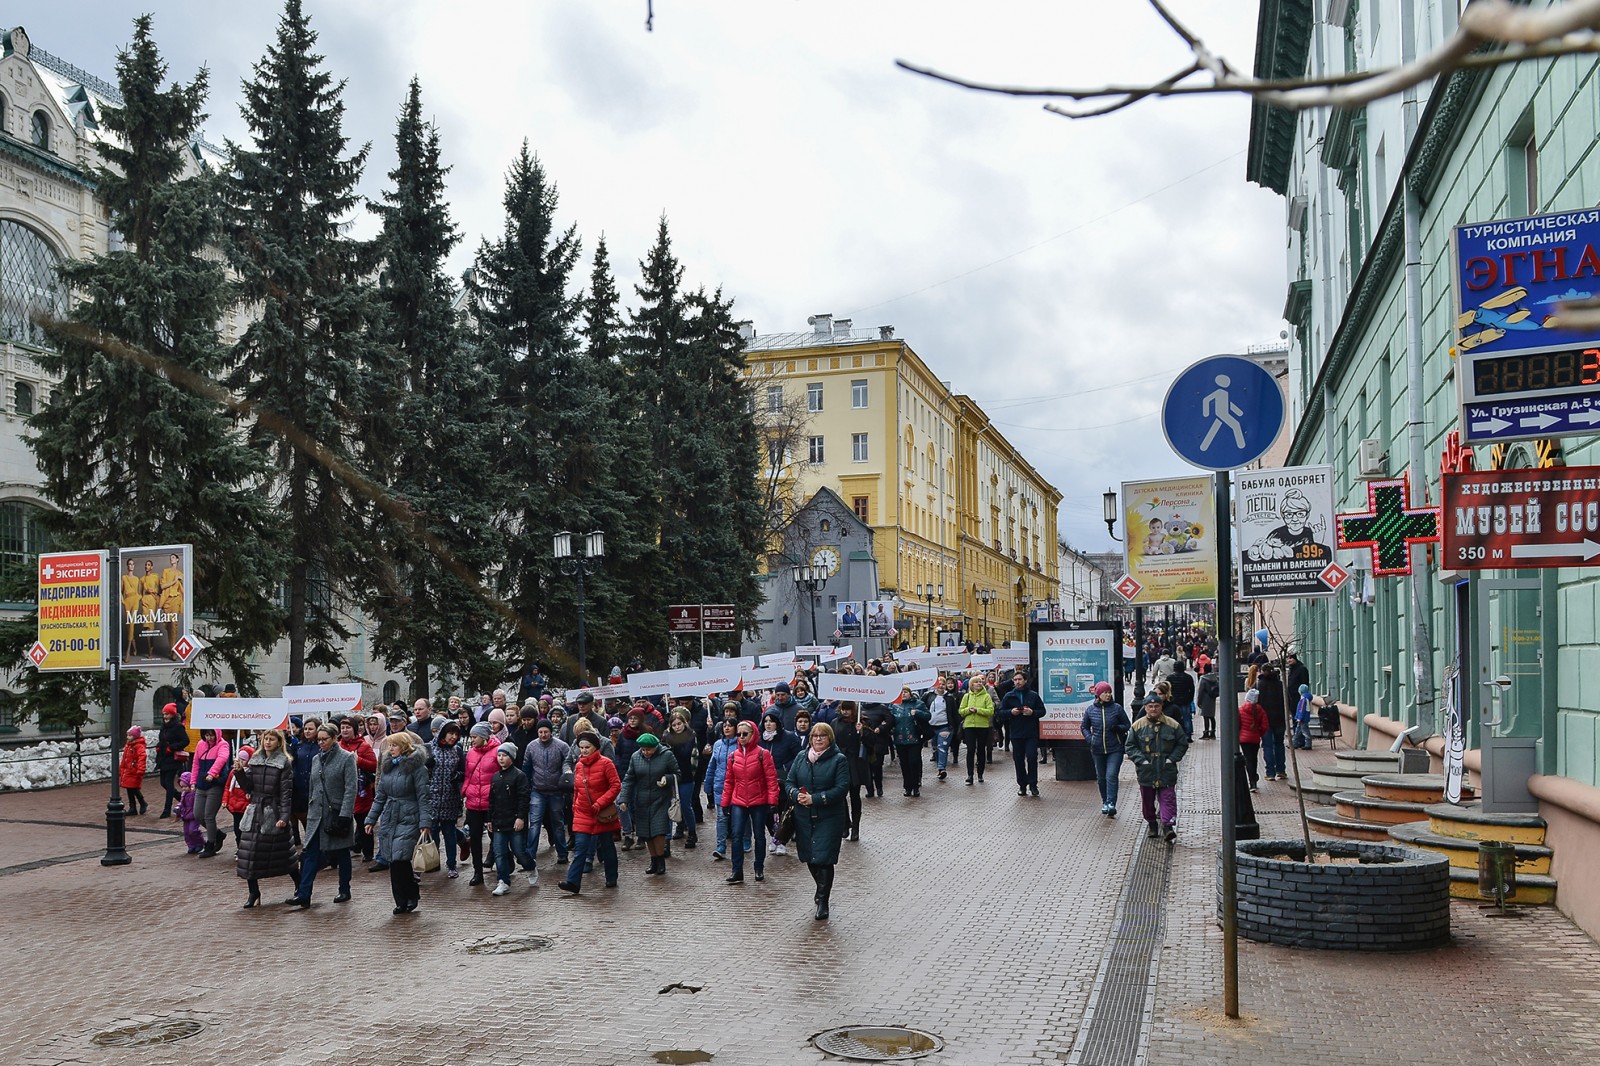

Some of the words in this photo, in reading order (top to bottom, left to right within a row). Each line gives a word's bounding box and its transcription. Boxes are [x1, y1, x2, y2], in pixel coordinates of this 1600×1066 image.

[1464, 211, 1600, 239] ТУРИСТИЧЕСКАЯ
[1487, 229, 1577, 251] КОМПАНИЯ
[1471, 408, 1489, 418] Ул.
[1492, 401, 1568, 417] Грузинская
[1160, 484, 1203, 492] МЕДИЦИНСКАЯ
[1242, 479, 1275, 490] БАБУЛЯ
[1279, 474, 1326, 487] ОДОБРЯЕТ
[1462, 477, 1600, 496] ХУДОЖЕСТВЕННЫ
[1161, 499, 1190, 507] Персона
[1247, 497, 1276, 514] ЛЕПИ
[1456, 497, 1542, 536] МУЗЕЙ
[1458, 547, 1486, 560] 350
[56, 568, 98, 578] ЭКСПЕРТ
[1243, 562, 1281, 572] ПЕЛЬМЕНИ
[1282, 561, 1288, 569] И
[1290, 559, 1327, 569] ВАРЕНИКИ
[41, 585, 99, 601] МЕДСПРАВКИ
[41, 604, 100, 620] МЕДКНИЖКИ
[126, 608, 178, 624] MaxMara
[50, 638, 100, 652] 261-00-01
[698, 678, 729, 686] ВЫСЫПАЙТЕСЬ
